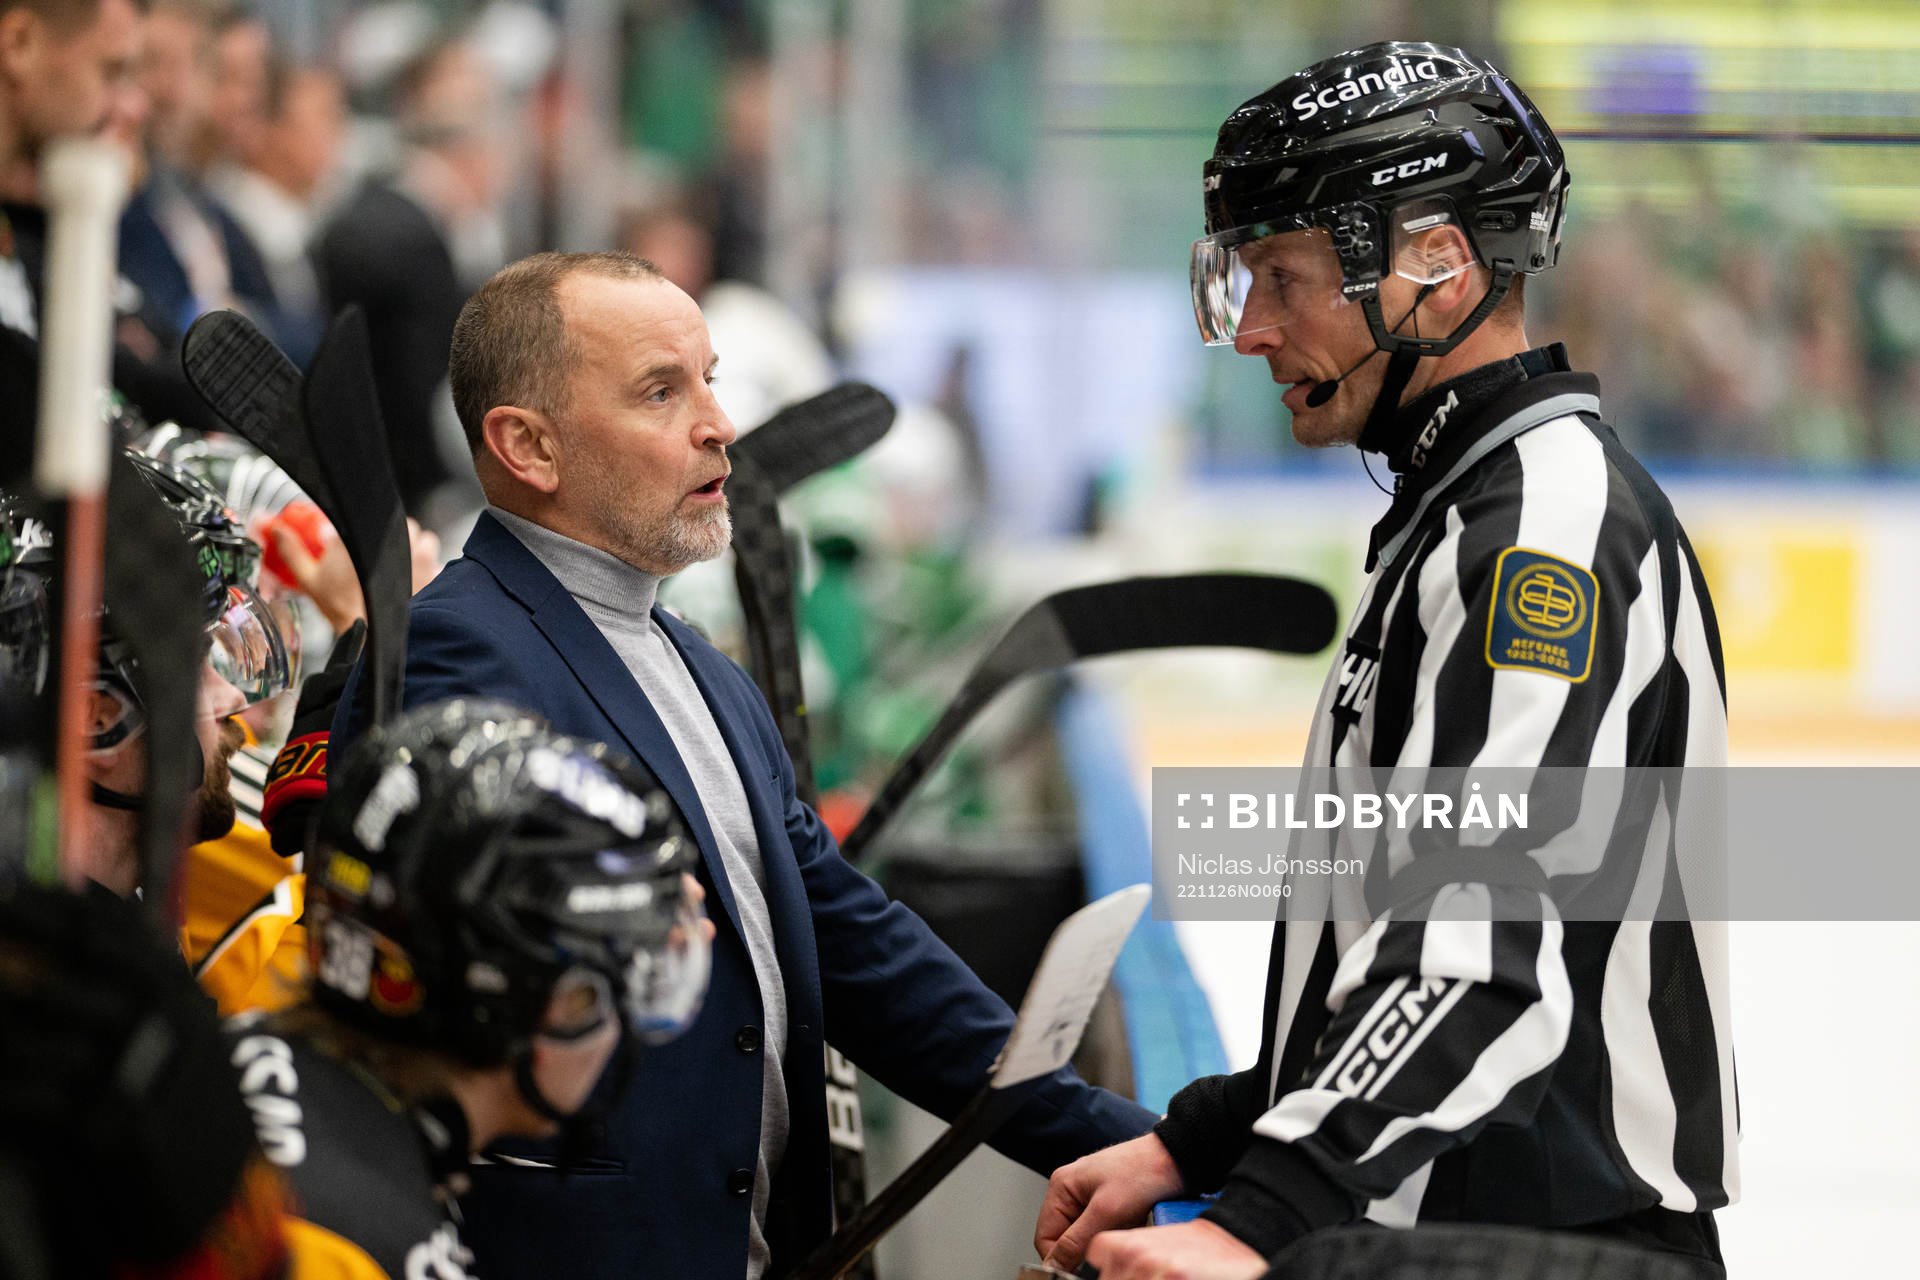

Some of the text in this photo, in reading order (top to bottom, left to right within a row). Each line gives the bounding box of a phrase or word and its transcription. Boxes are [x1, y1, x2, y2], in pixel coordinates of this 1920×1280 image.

[1292, 57, 1439, 121] Scandic
[1371, 152, 1449, 187] CCM
[1343, 282, 1377, 293] CCM
[1411, 389, 1459, 469] CCM
[1336, 977, 1447, 1098] CCM
